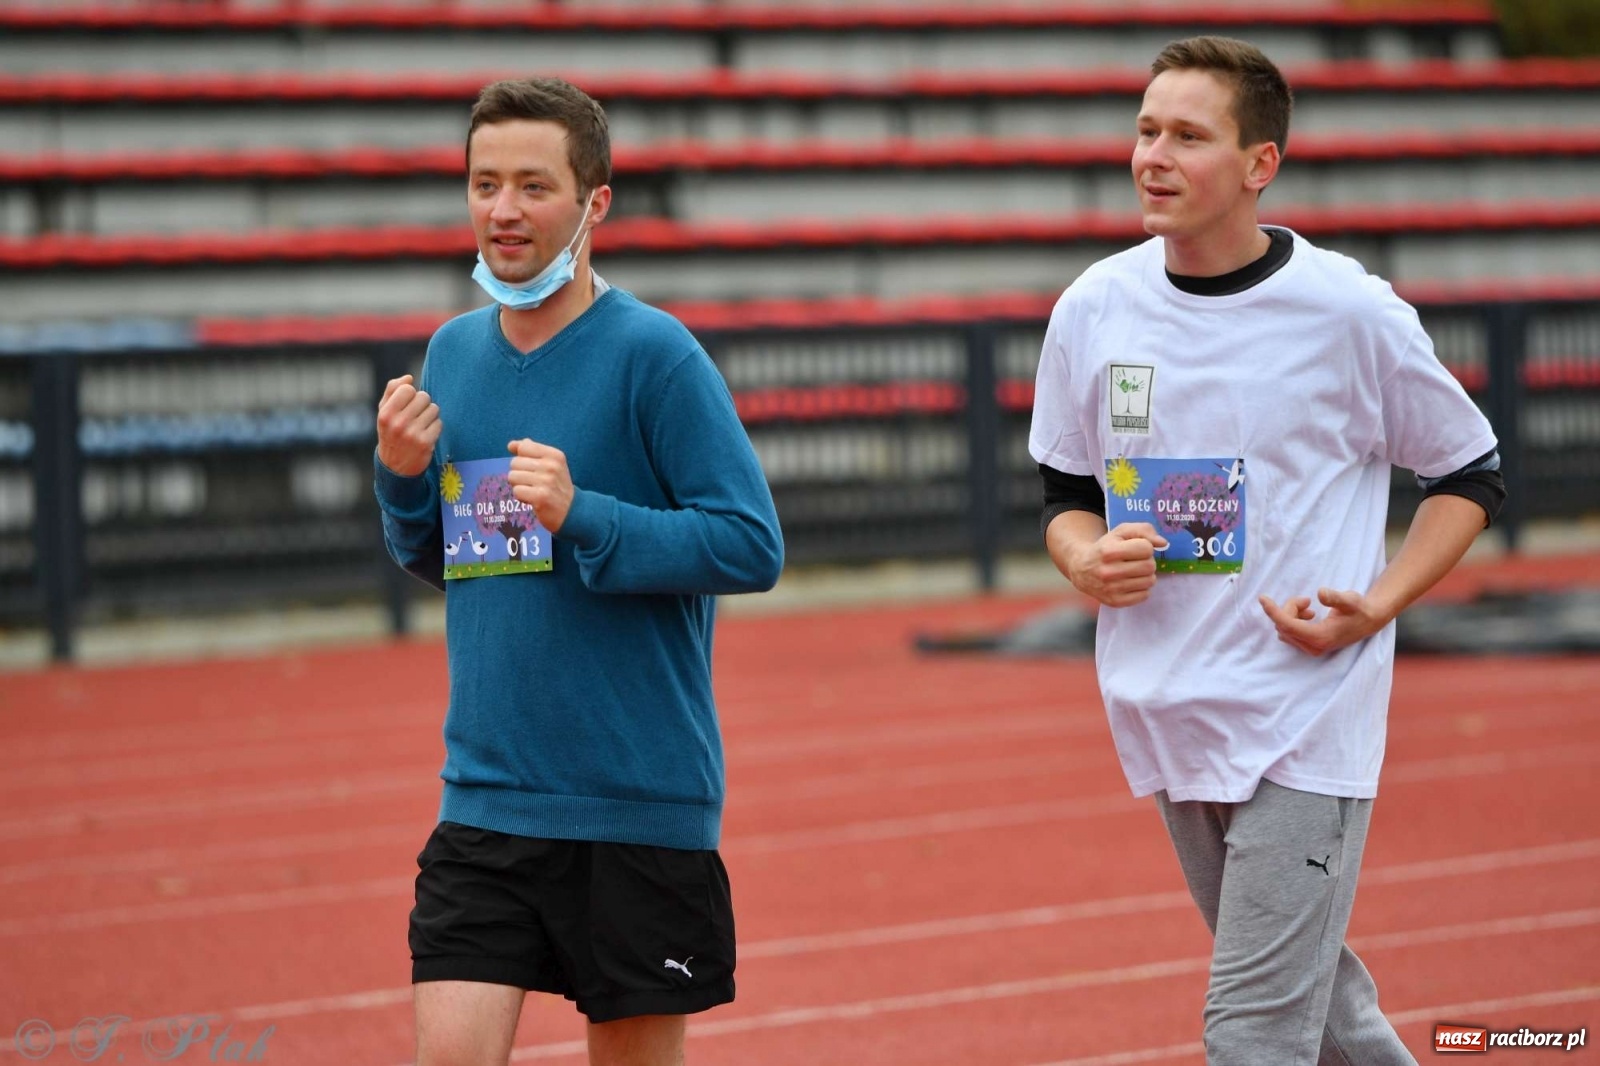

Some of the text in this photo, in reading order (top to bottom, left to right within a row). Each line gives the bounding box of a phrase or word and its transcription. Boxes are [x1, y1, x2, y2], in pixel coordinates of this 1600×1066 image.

[453, 504, 472, 518] BIEG
[477, 502, 494, 516] DLA
[1126, 497, 1239, 513] BIEG DLA BOŻENY
[507, 536, 540, 557] 013
[1191, 532, 1237, 557] 306
